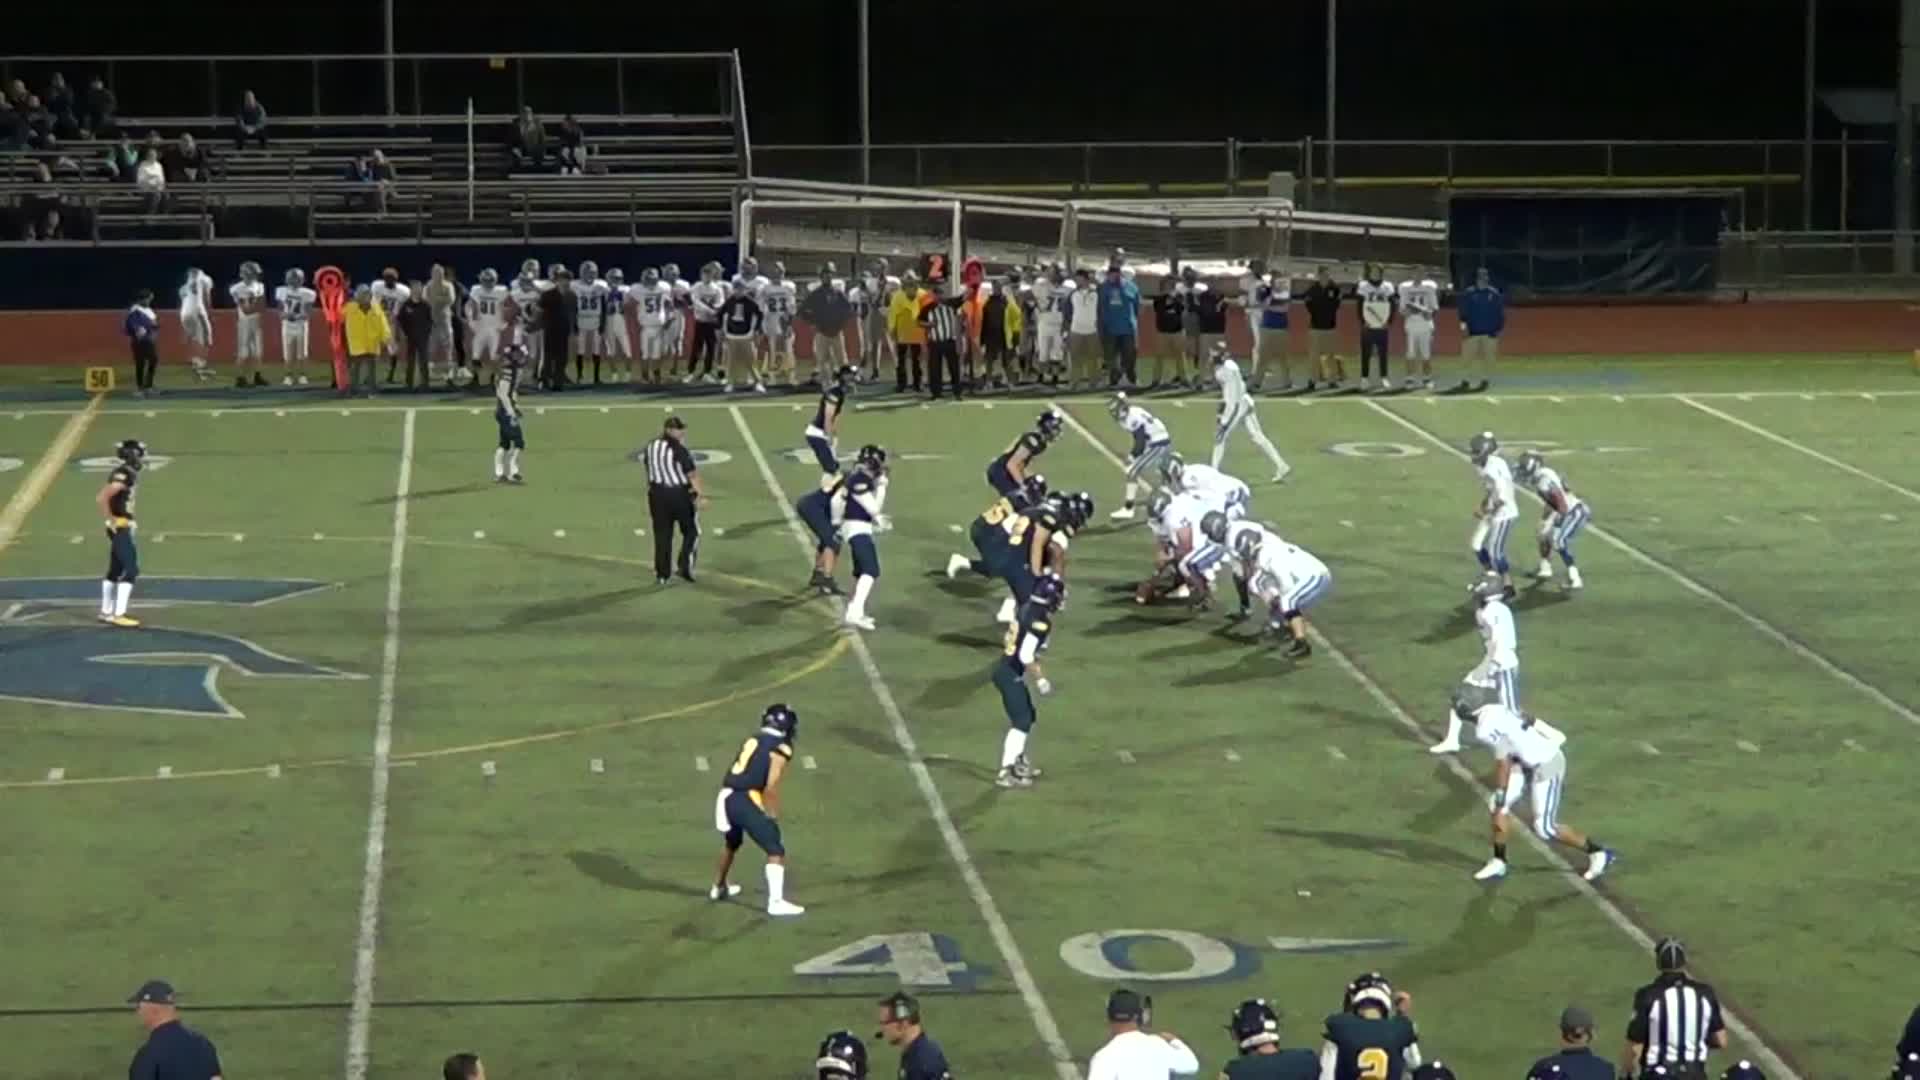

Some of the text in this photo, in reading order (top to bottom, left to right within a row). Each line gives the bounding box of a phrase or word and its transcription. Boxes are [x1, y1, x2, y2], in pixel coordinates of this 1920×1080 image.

[929, 254, 944, 279] 2
[91, 369, 109, 387] 50
[792, 930, 1240, 986] 40
